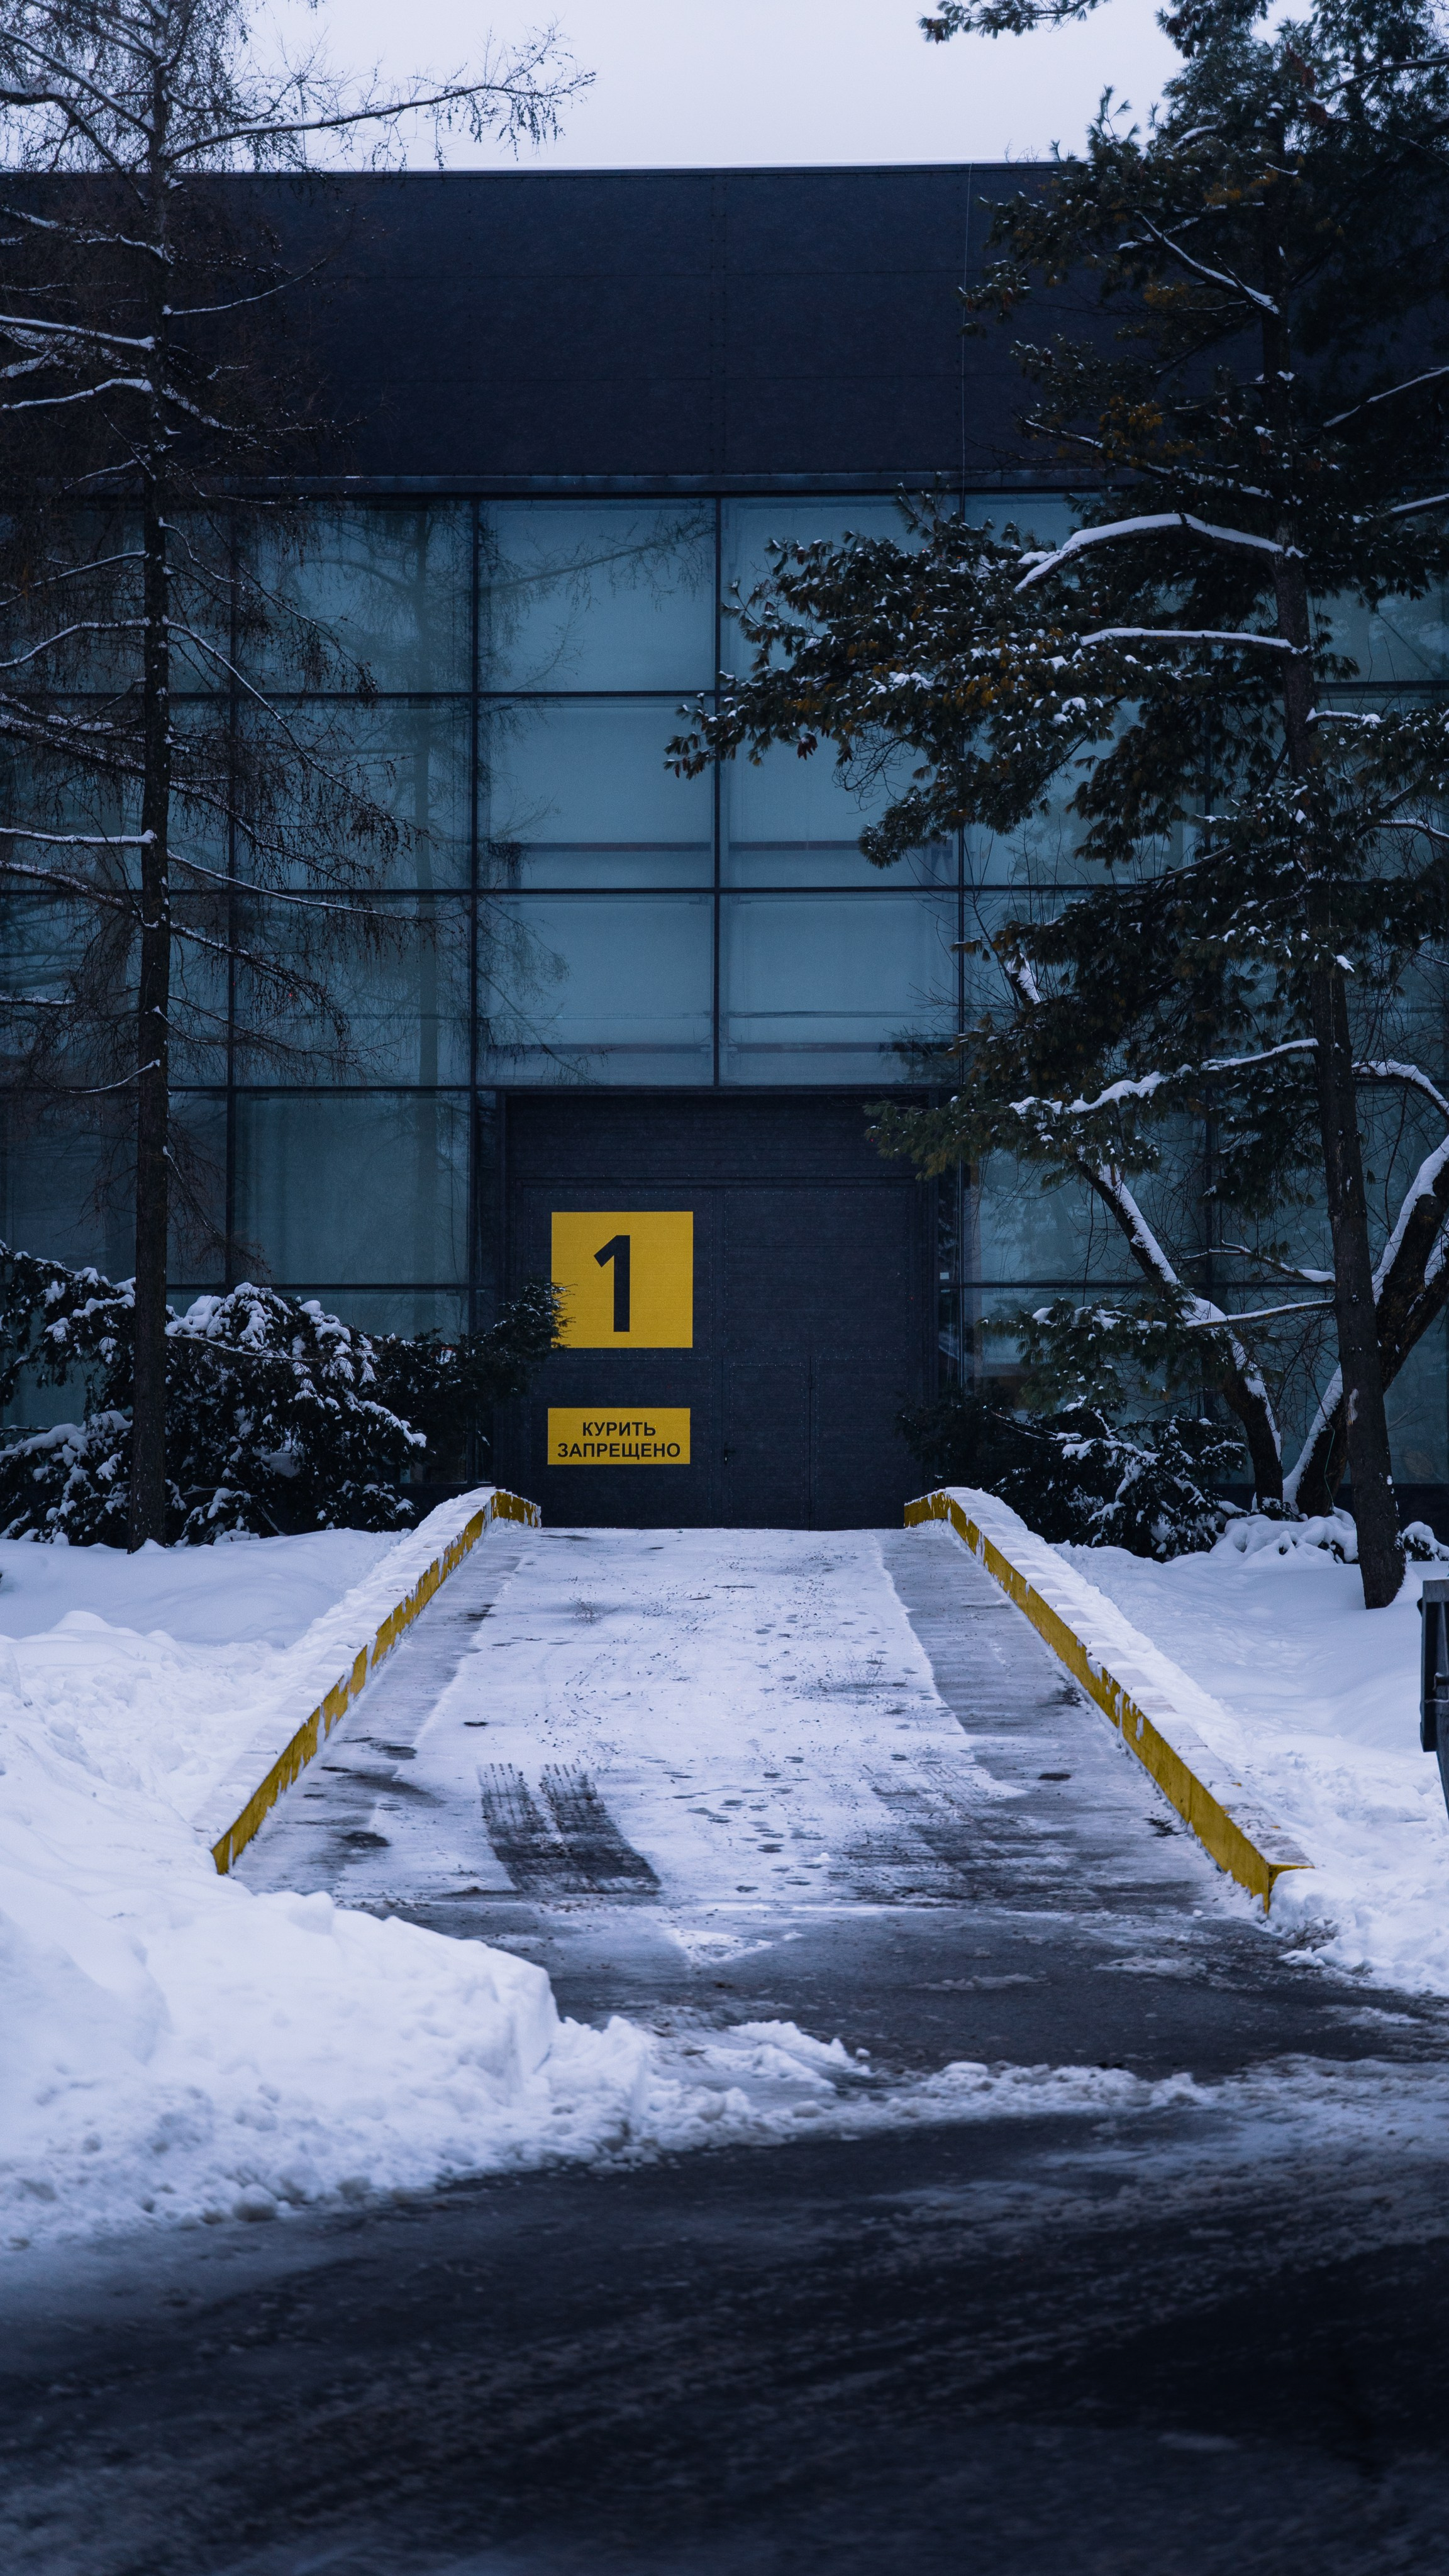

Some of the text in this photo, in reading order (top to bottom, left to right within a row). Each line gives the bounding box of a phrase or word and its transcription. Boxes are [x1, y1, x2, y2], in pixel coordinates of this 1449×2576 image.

[594, 1235, 630, 1332] 1
[582, 1421, 656, 1436] КУРИТЬ
[557, 1443, 680, 1460] ЗАПРЕЩЕНО
